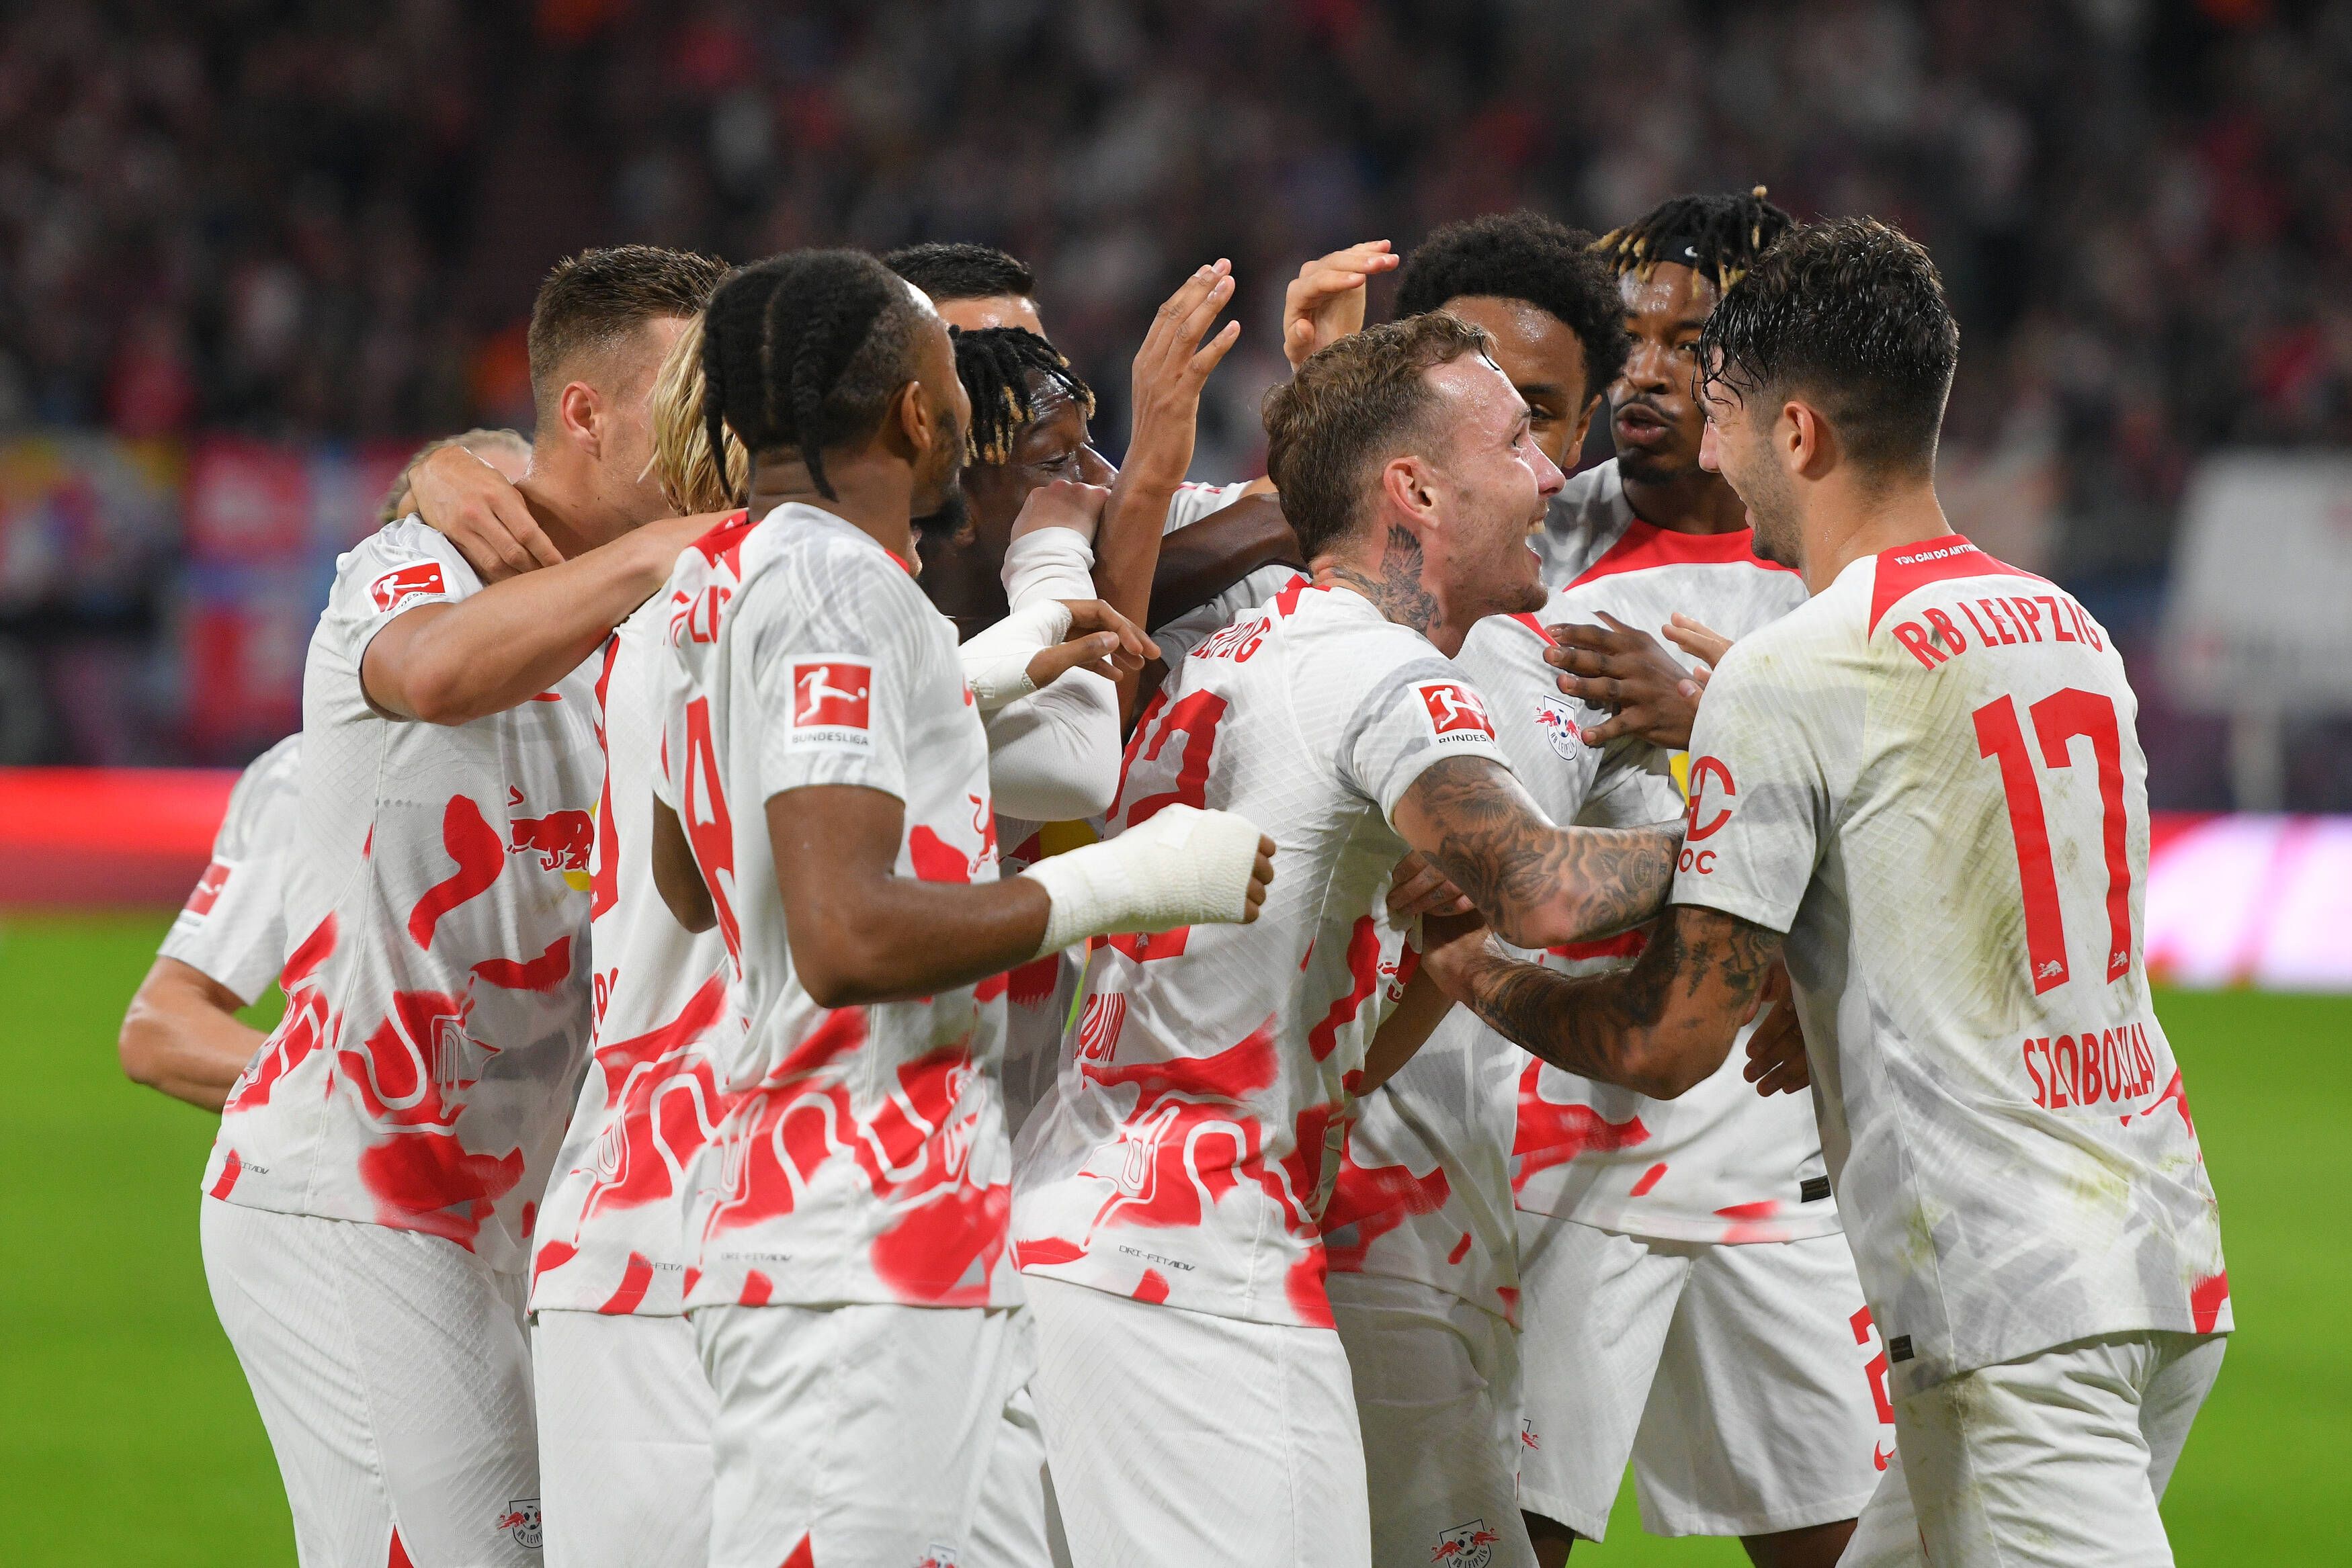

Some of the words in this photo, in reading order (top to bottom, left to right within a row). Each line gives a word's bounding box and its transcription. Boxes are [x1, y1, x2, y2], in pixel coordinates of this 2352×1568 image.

[1894, 555, 1915, 565] YOU
[1935, 548, 1948, 560] DO
[1892, 607, 1968, 671] RB
[1956, 596, 2102, 652] LEIPZIG
[792, 731, 869, 746] BUNDESLIGA
[1972, 687, 2132, 996] 17
[1678, 848, 1717, 875] OC
